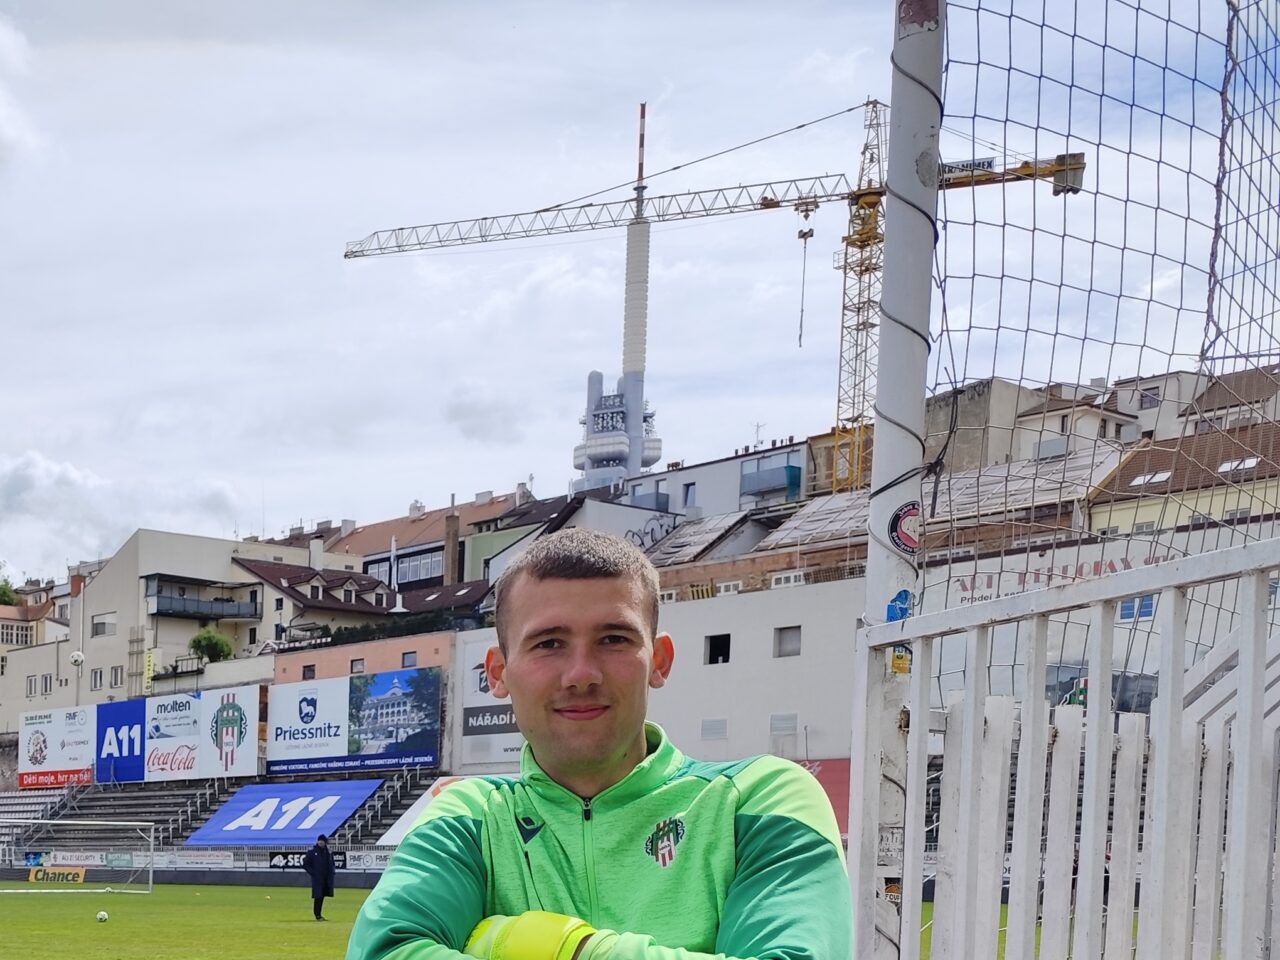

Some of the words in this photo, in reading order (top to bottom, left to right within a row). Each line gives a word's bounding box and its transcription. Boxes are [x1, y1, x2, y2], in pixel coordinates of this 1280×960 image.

[156, 700, 191, 714] molten
[468, 711, 511, 727] NÁŘADÍ
[274, 722, 341, 742] Priessnitz
[100, 724, 141, 758] A11
[222, 795, 341, 831] A11
[287, 854, 306, 866] SEC
[34, 869, 80, 882] Chance
